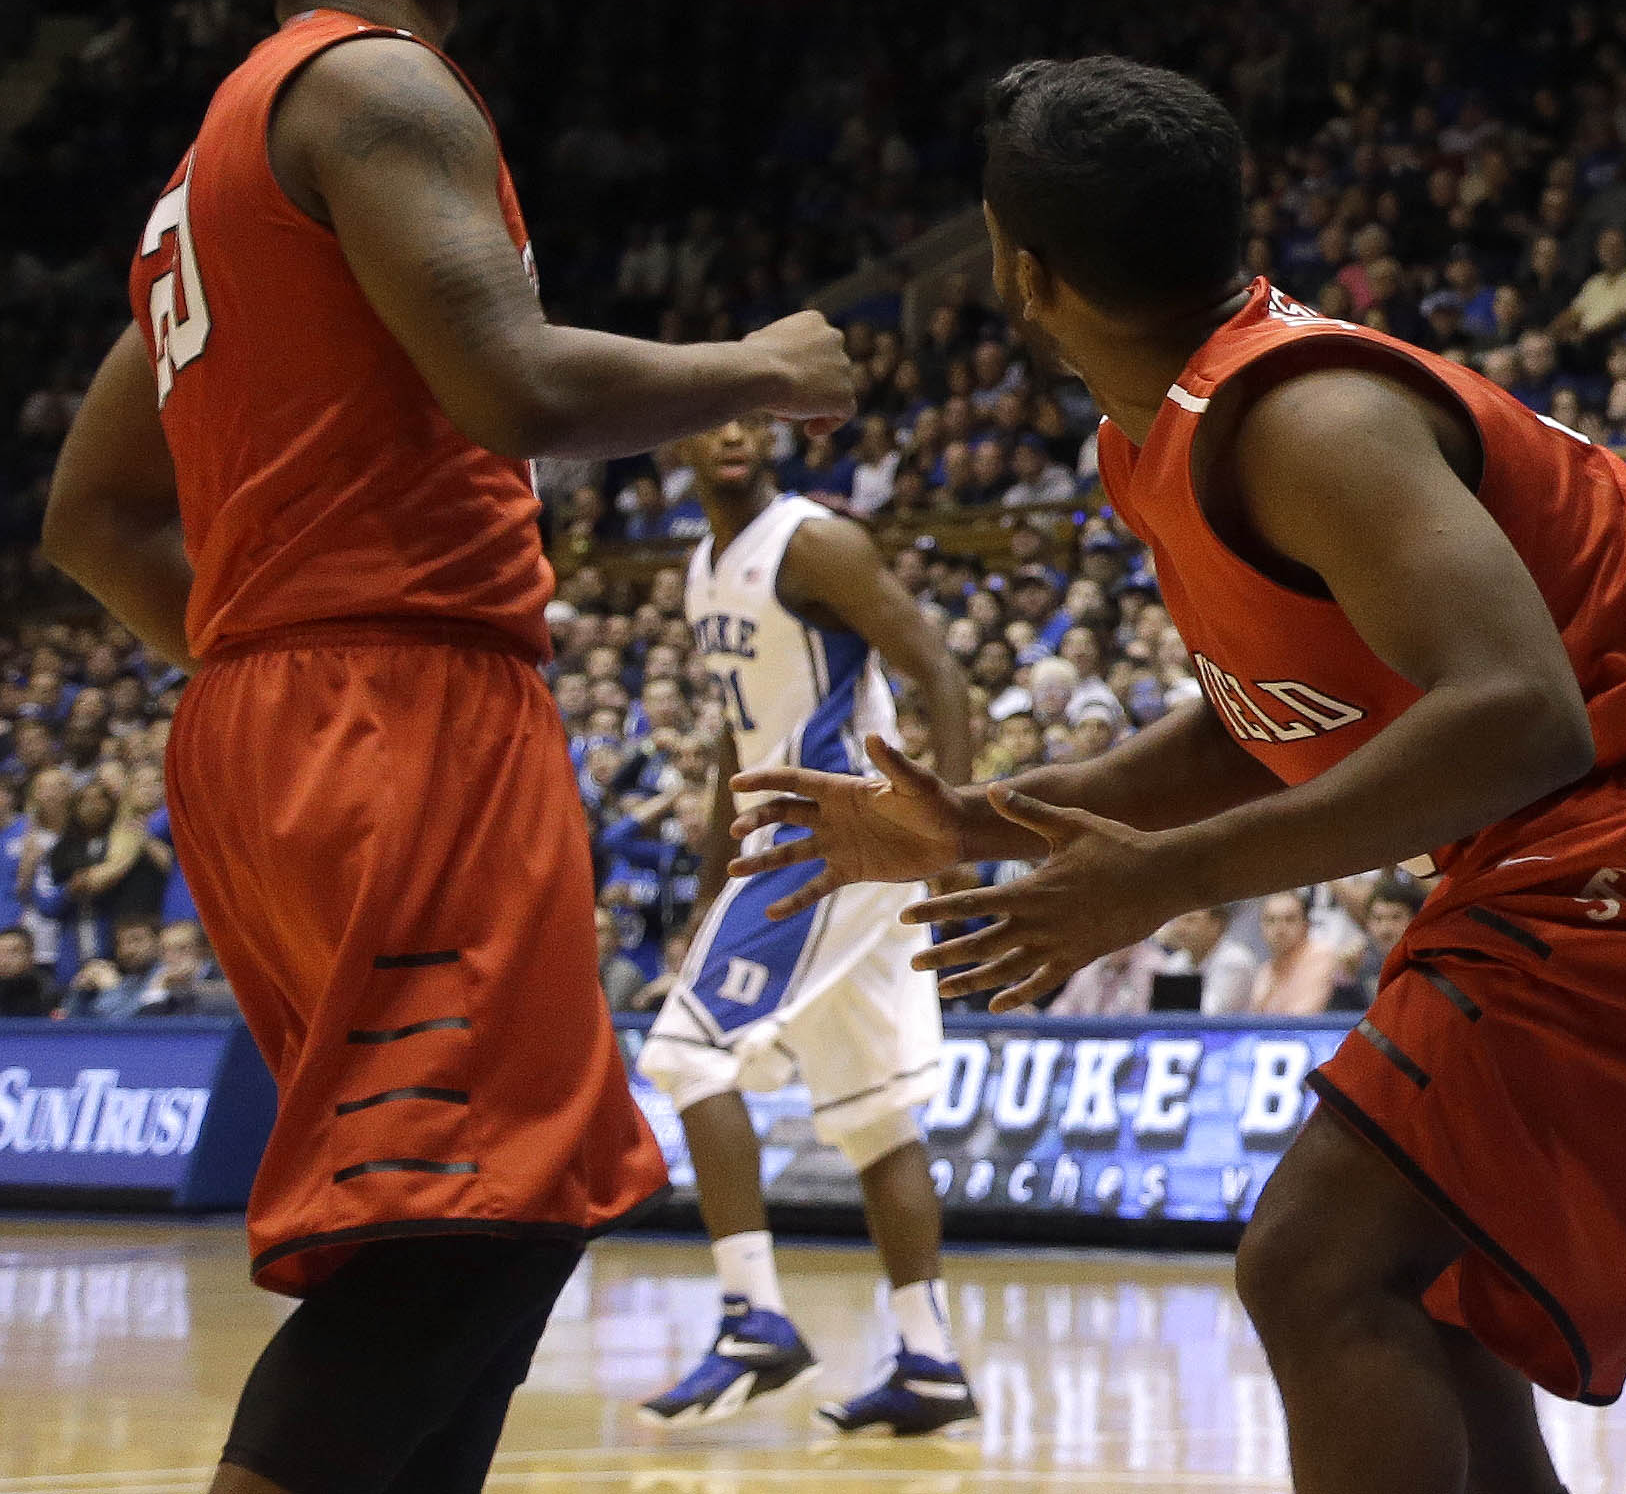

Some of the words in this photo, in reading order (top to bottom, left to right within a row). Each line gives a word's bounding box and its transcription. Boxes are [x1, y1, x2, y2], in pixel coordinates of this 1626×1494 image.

[1194, 652, 1365, 743] IELD
[718, 956, 770, 1005] D
[923, 1039, 1204, 1135] DUKE
